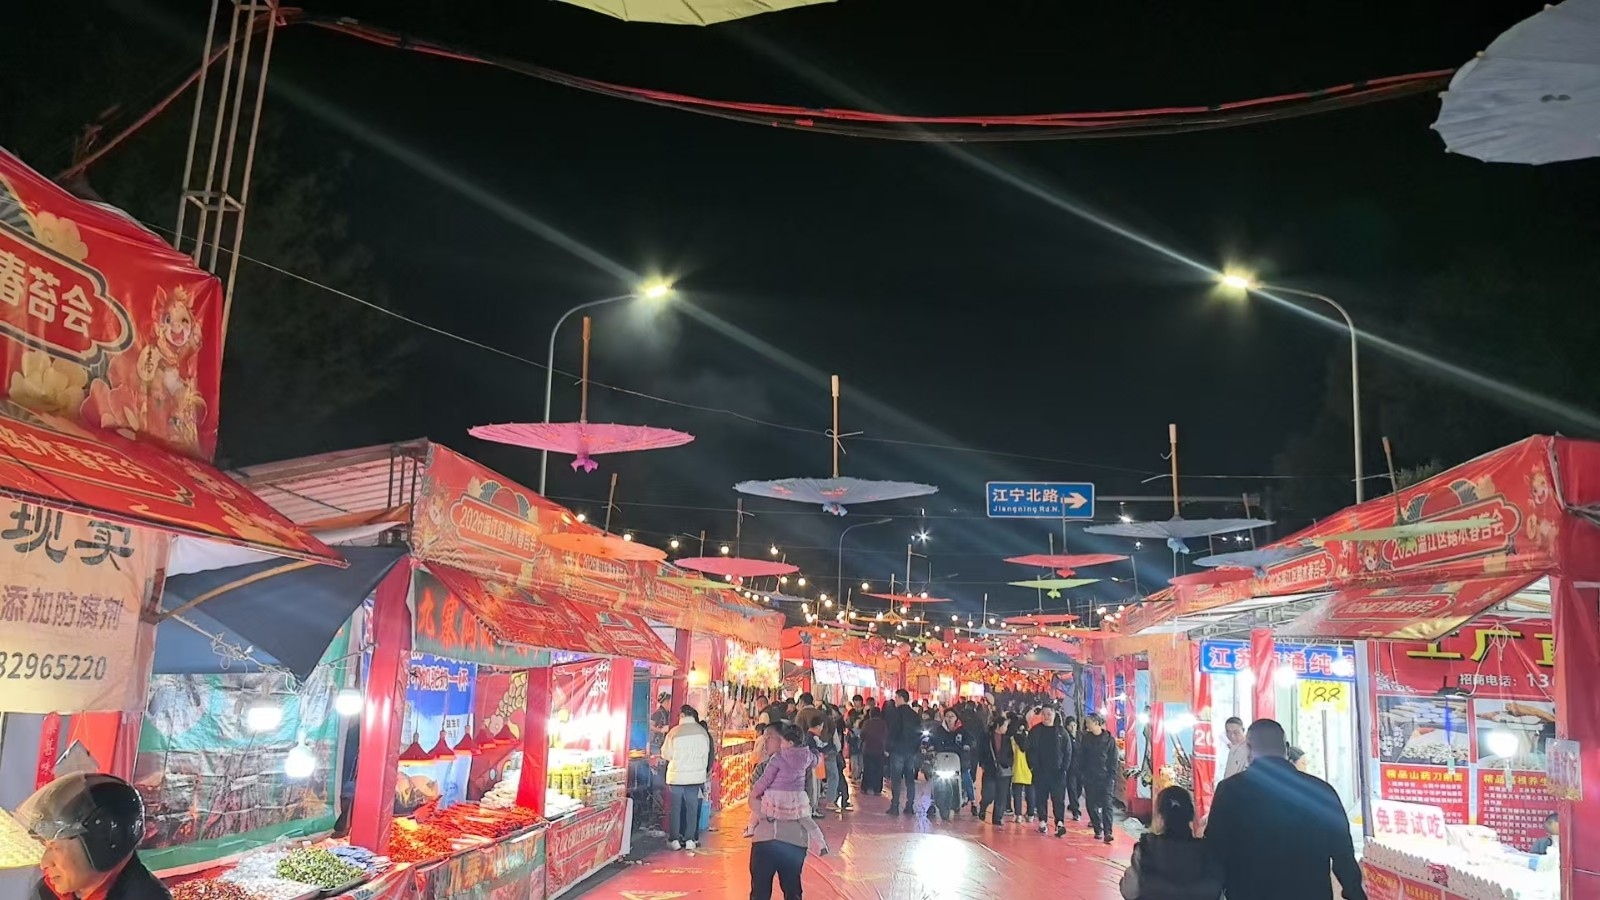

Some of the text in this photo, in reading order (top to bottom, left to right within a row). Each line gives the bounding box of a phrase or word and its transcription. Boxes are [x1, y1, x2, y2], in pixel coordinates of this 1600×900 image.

[993, 488, 1058, 503] 江宁北路
[993, 506, 1037, 514] Jiangning
[1210, 647, 1354, 676] 江苏通纯
[1527, 673, 1555, 688] 13
[1376, 807, 1444, 839] 免费试吃
